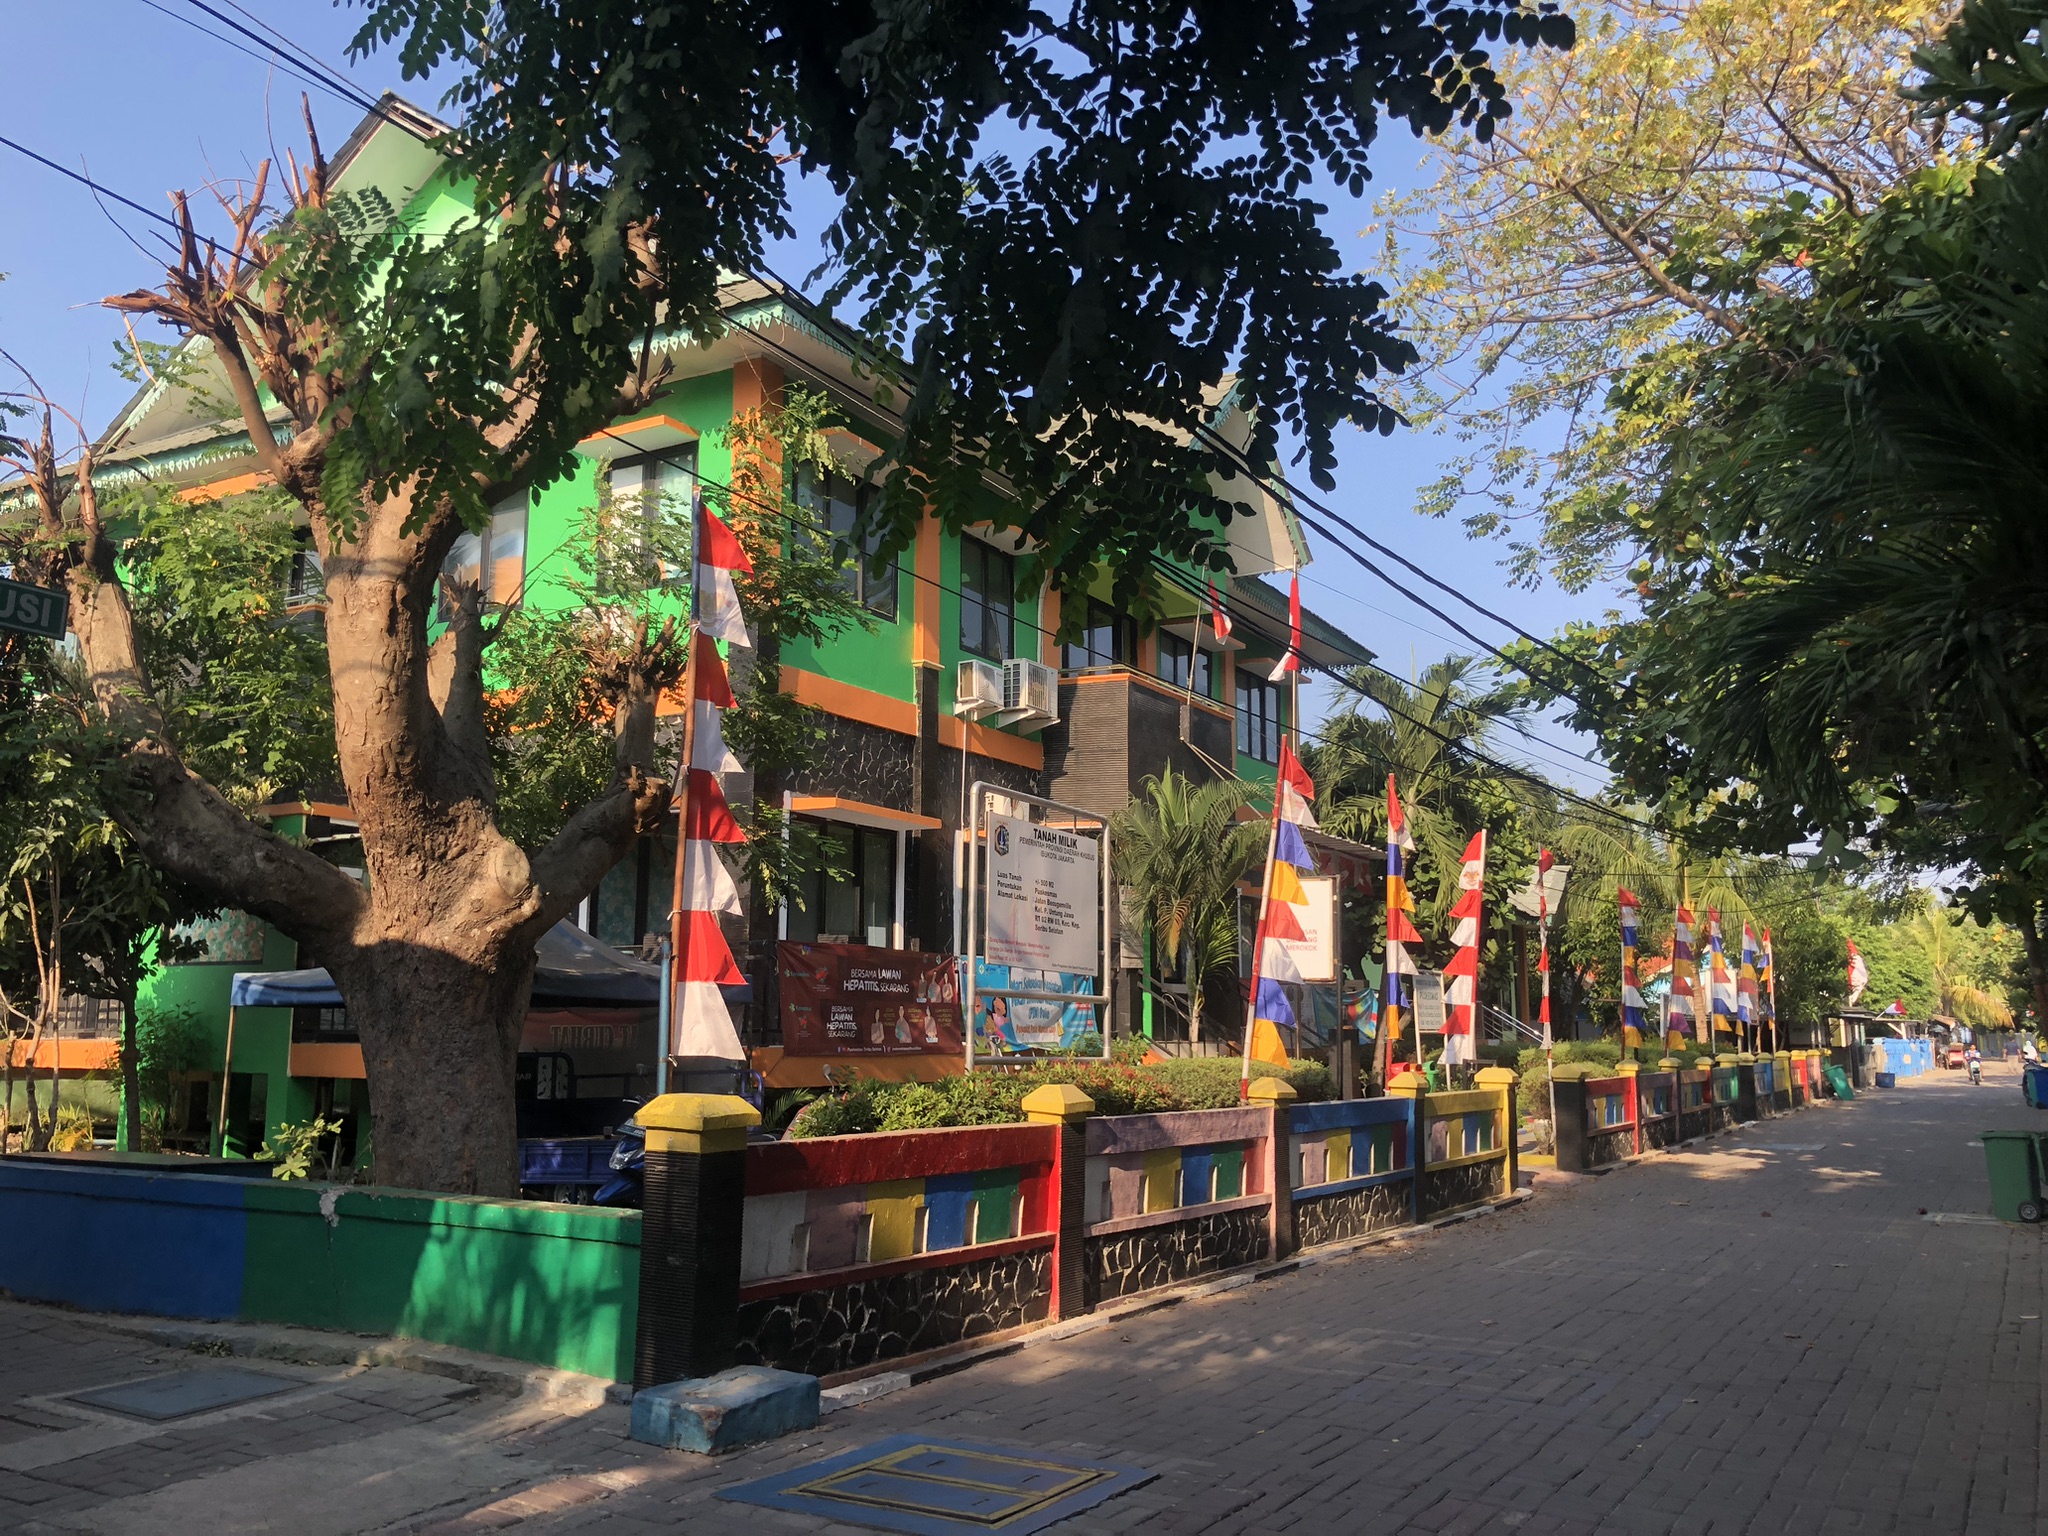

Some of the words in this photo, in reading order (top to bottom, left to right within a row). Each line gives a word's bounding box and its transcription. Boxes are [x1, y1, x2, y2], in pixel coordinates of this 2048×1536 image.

[1033, 828, 1057, 844] TANAH
[1058, 832, 1078, 849] MILIK
[1020, 836, 1045, 848] PEMERINTAH
[1064, 846, 1080, 857] DAERAH
[1080, 850, 1095, 861] KHUSUS
[1058, 854, 1075, 864] JAKARTA
[997, 870, 1008, 879] Luas
[1009, 873, 1022, 882] Tanah
[997, 880, 1022, 891] Peruntukan
[997, 890, 1013, 899] Alamat
[1014, 892, 1028, 901] Lokasi
[1034, 888, 1058, 898] Puskesmas
[1034, 896, 1046, 905] Jalan
[1034, 906, 1043, 914] Kel.
[1049, 909, 1062, 918] Untung
[1064, 911, 1074, 919] Jawa
[1034, 924, 1048, 932] Seribu
[1048, 927, 1063, 935] Selatan
[850, 968, 877, 979] BERSAMA
[878, 968, 902, 980] LAWAN
[880, 982, 910, 994] SEKARANG
[830, 1013, 853, 1021] LAWAN
[827, 1030, 856, 1038] SEKARANG
